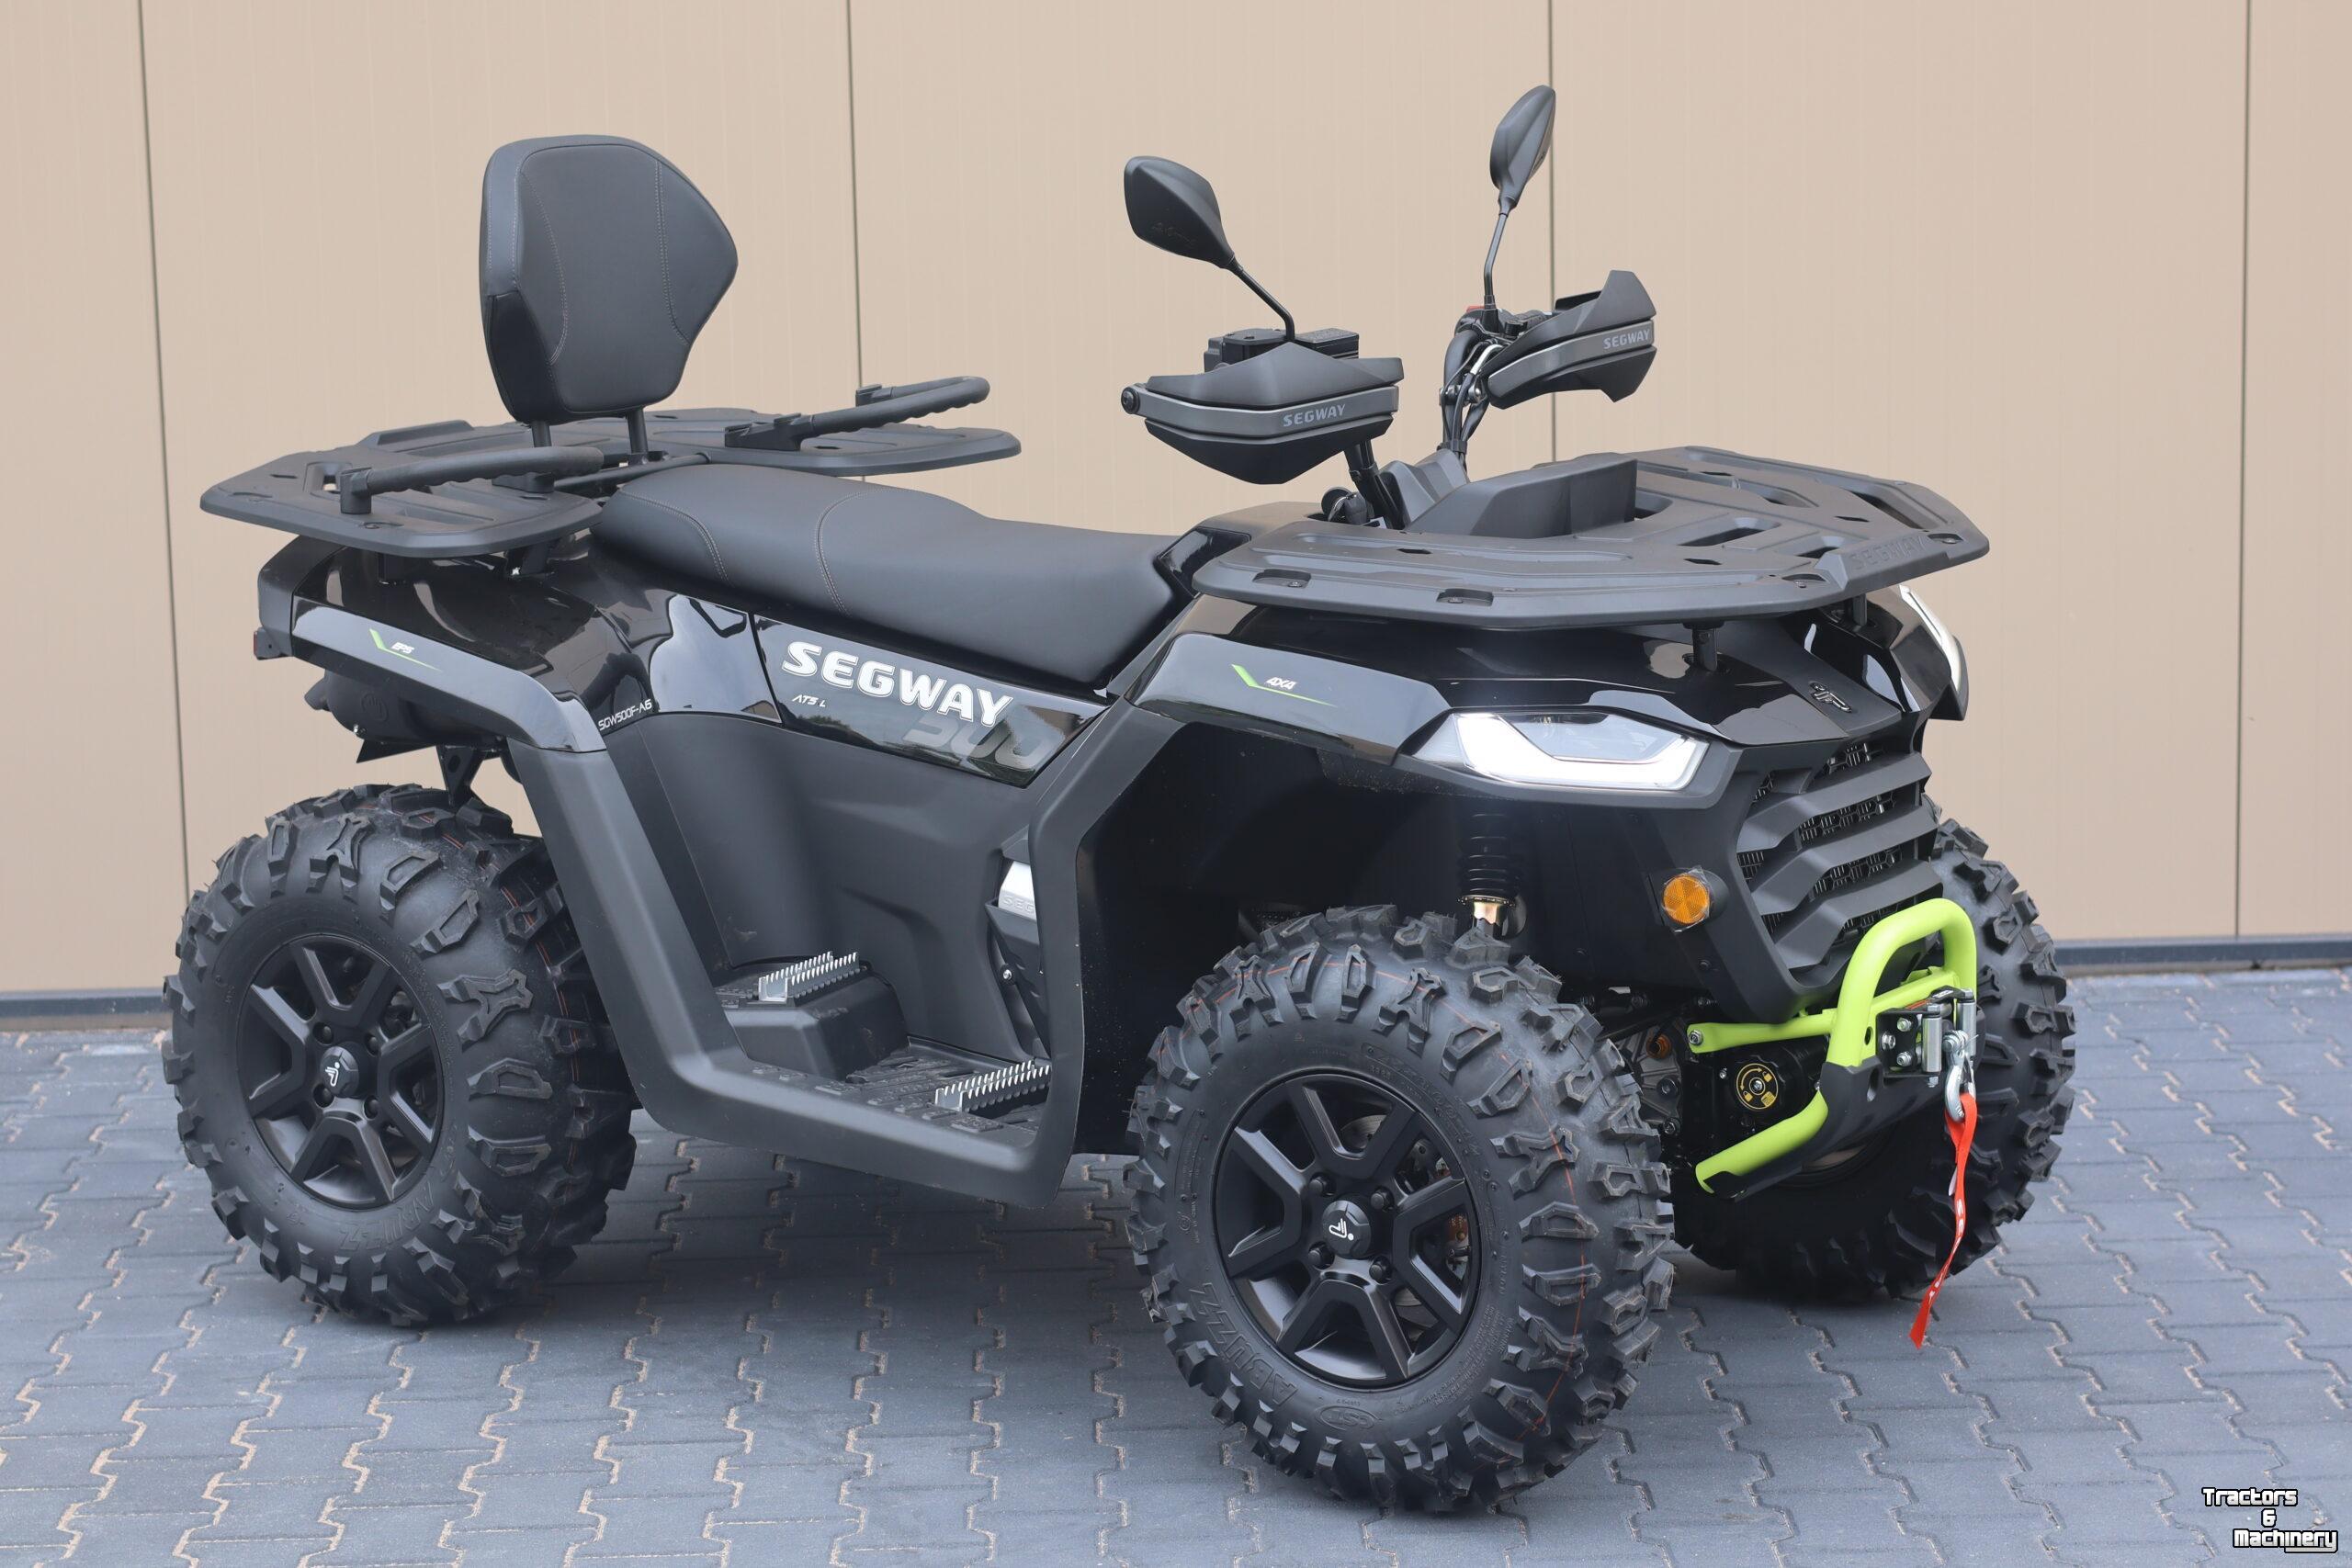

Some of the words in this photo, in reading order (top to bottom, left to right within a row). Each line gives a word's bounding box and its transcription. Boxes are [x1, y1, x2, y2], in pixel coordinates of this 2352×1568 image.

[1602, 329, 1650, 350] SEGWAY
[1283, 404, 1345, 427] SEGWAY
[1848, 535, 1928, 570] SEGWAY
[781, 640, 1013, 728] SEGWAY
[597, 698, 652, 731] SGW500F-A6
[1002, 896, 1035, 913] SEG
[1189, 1282, 1298, 1405] ABUZZ
